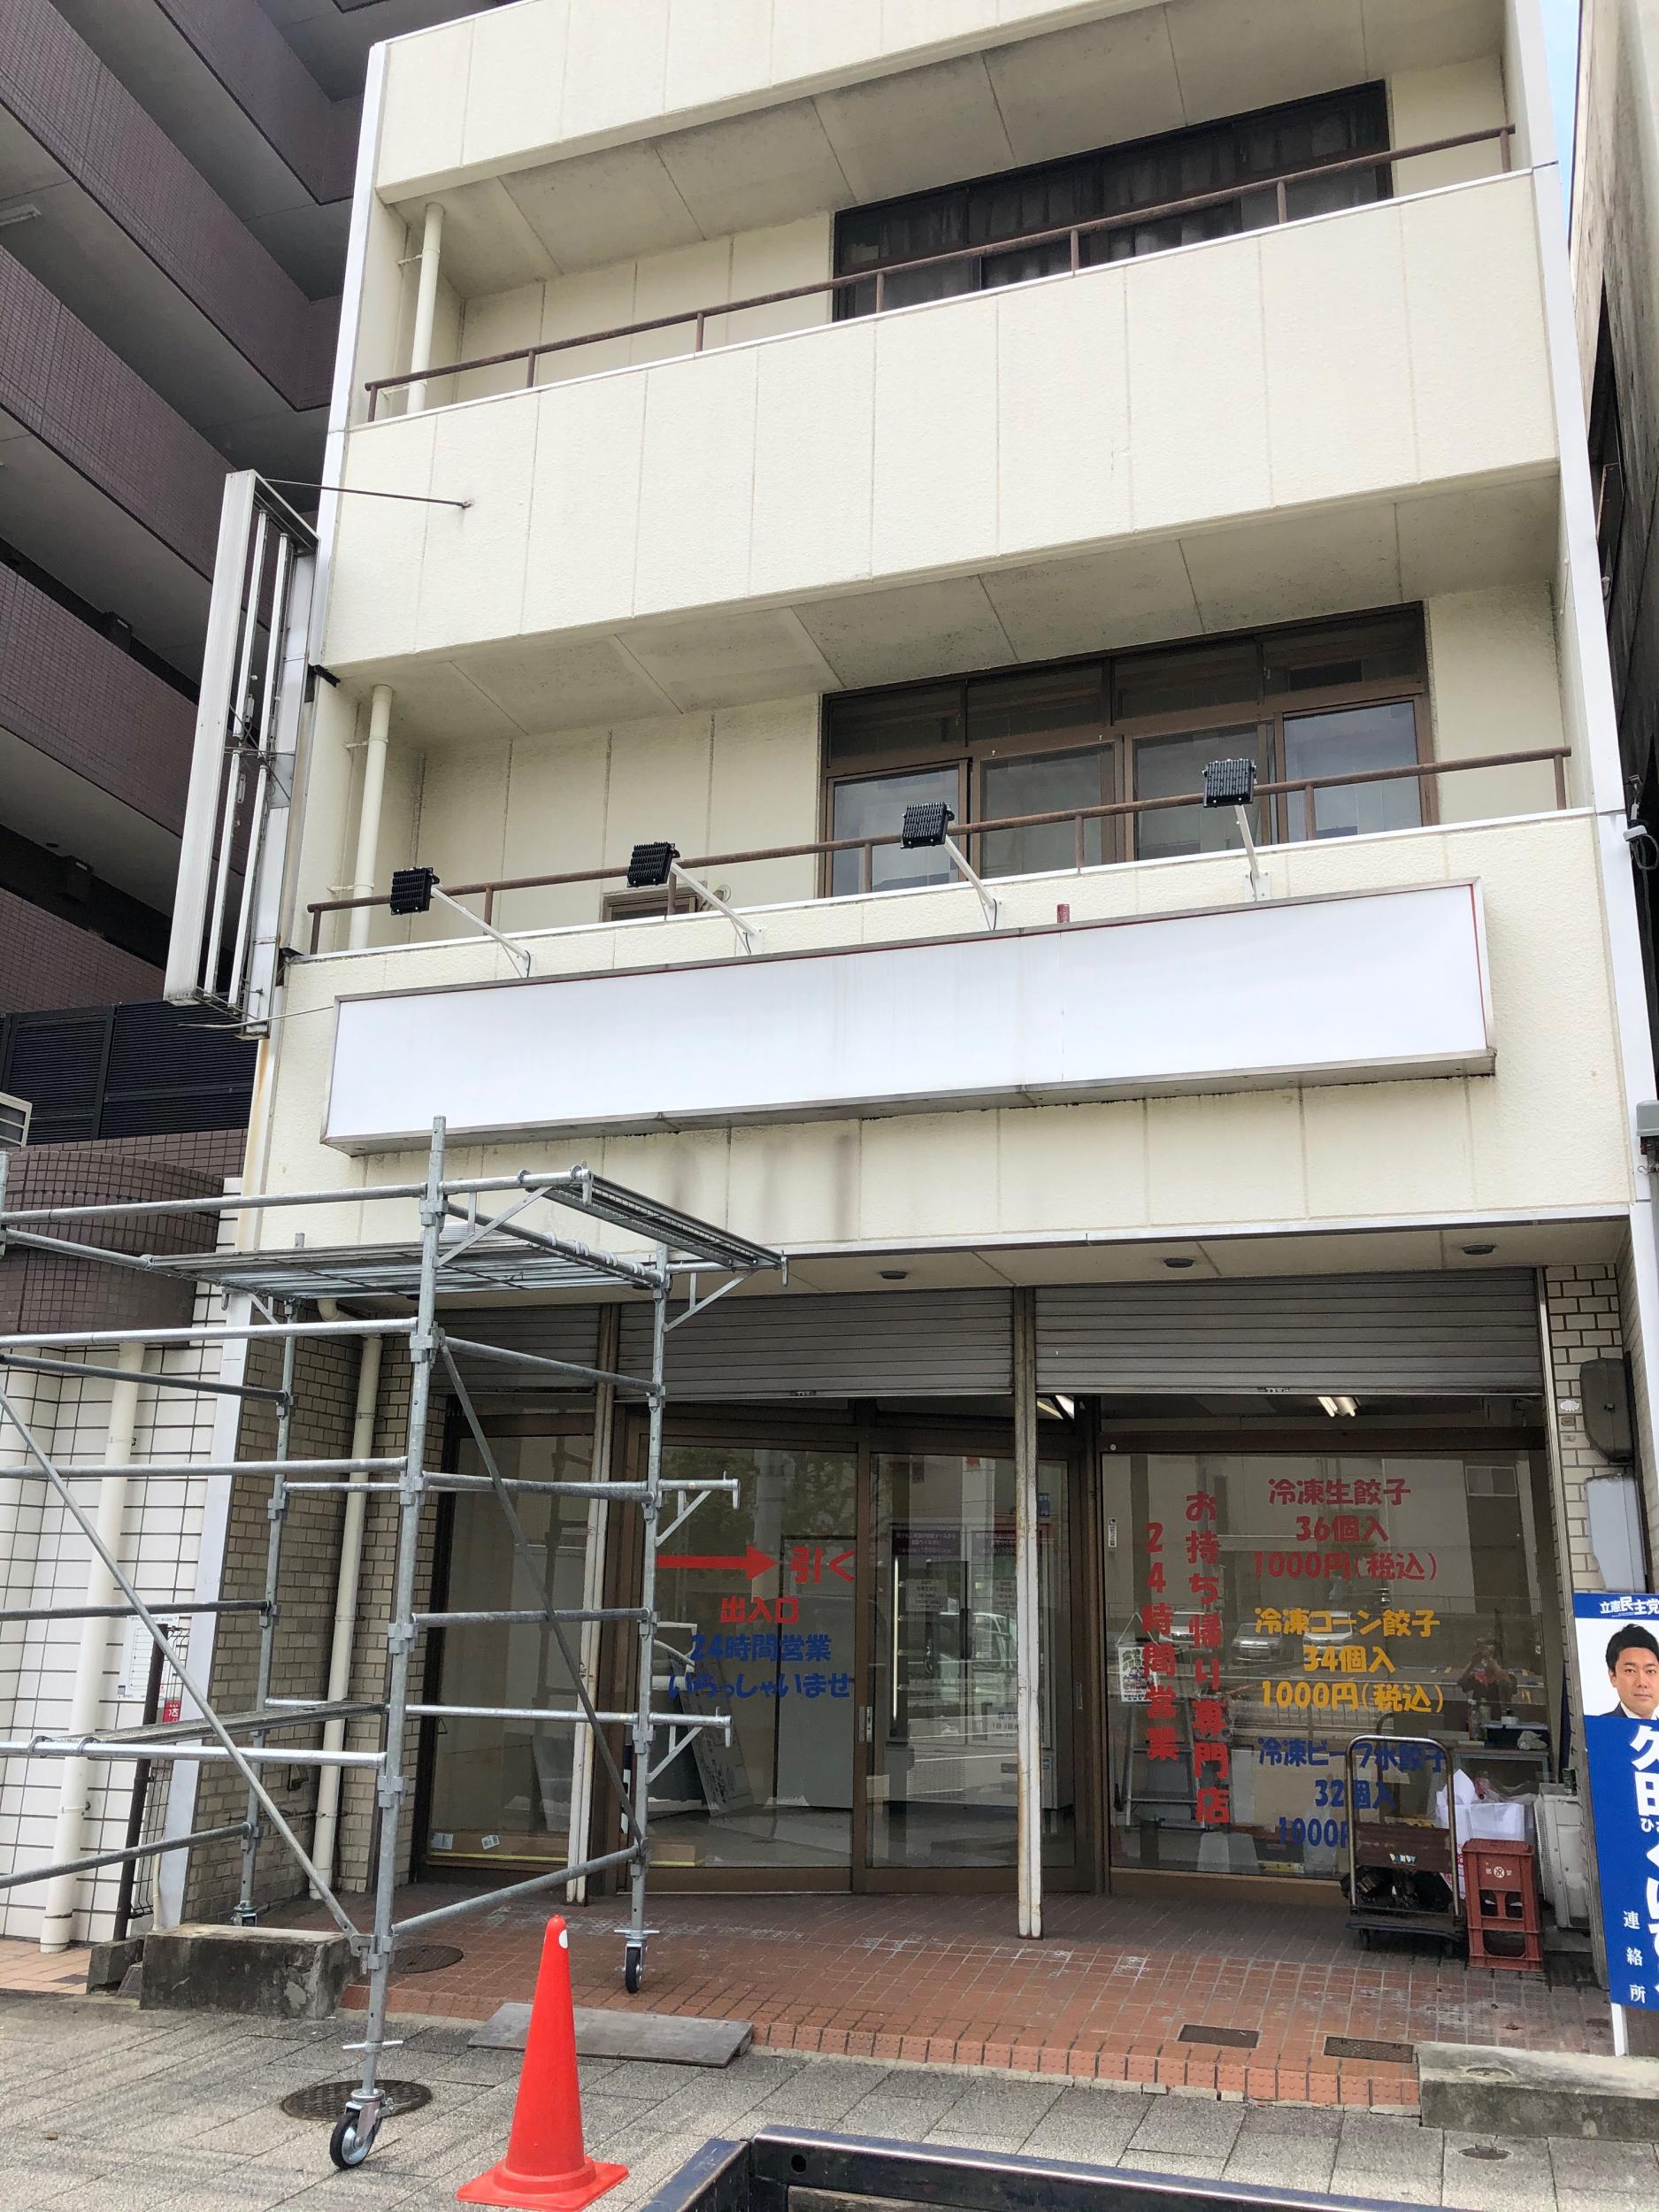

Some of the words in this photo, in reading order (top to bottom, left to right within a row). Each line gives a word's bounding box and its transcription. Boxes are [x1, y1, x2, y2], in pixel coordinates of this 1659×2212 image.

[1268, 1478, 1411, 1506] 冷凍生餃子
[1295, 1515, 1389, 1542] 36個入
[792, 1547, 856, 1584] 引く
[1253, 1550, 1437, 1580] 1000円(税込)
[720, 1594, 799, 1624] 出入口
[1600, 1596, 1659, 1616] 立憲民主党
[1254, 1607, 1440, 1637] 冷凍コーン餃子
[691, 1633, 832, 1662] 24時間営業
[1141, 1522, 1180, 1761] 24時間営業
[1185, 1490, 1230, 1824] お持ち帰り専門店
[1302, 1645, 1396, 1673] 34個入
[669, 1672, 850, 1699] いらっしゃいませ
[1262, 1679, 1444, 1713] 1000円(税込)
[1623, 1910, 1647, 2004] 連絡所
